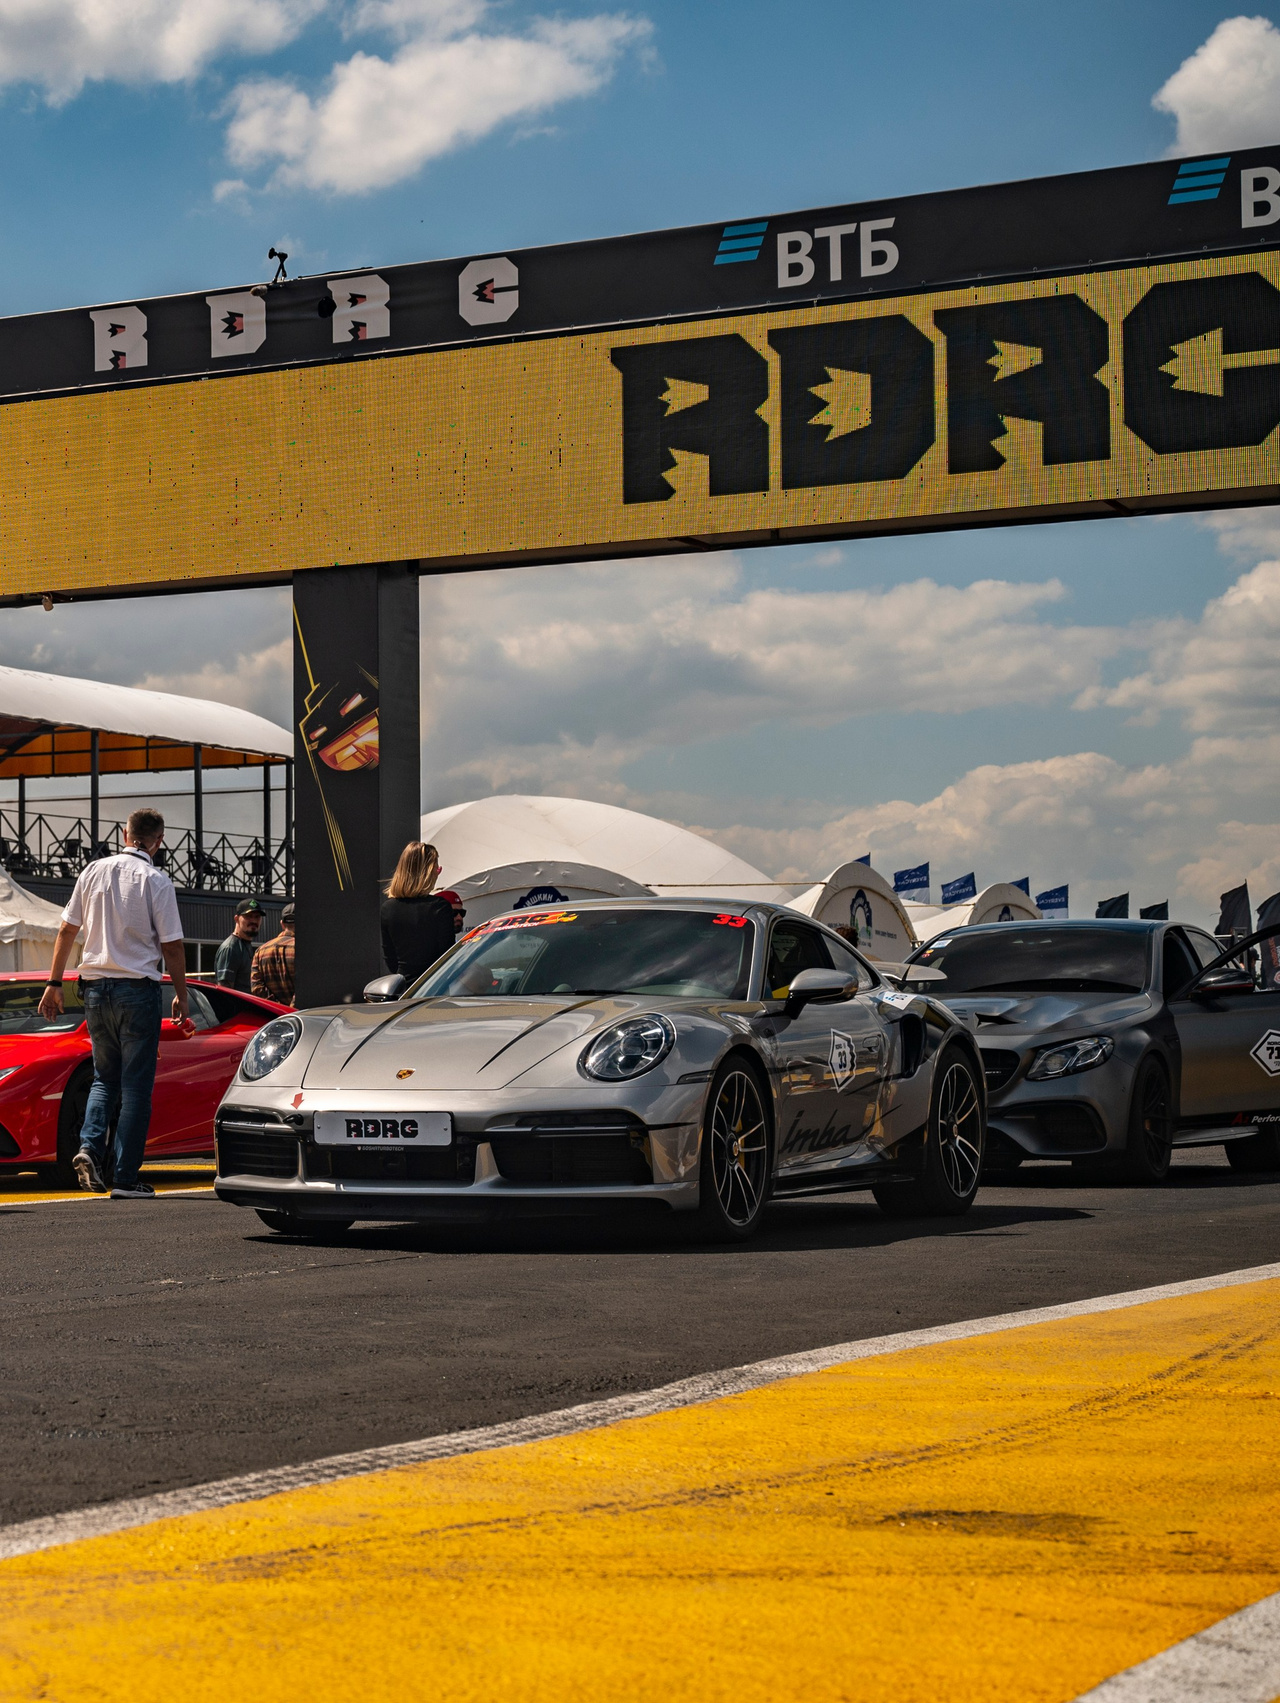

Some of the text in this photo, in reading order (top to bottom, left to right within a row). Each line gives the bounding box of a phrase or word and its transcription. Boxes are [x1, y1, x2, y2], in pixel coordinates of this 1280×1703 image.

[777, 216, 900, 289] ВТБ
[609, 271, 1280, 505] RDRC
[523, 893, 554, 908] ИШКИН
[712, 913, 748, 928] 33
[1251, 1114, 1280, 1123] Perfor
[344, 1118, 419, 1139] RDRC
